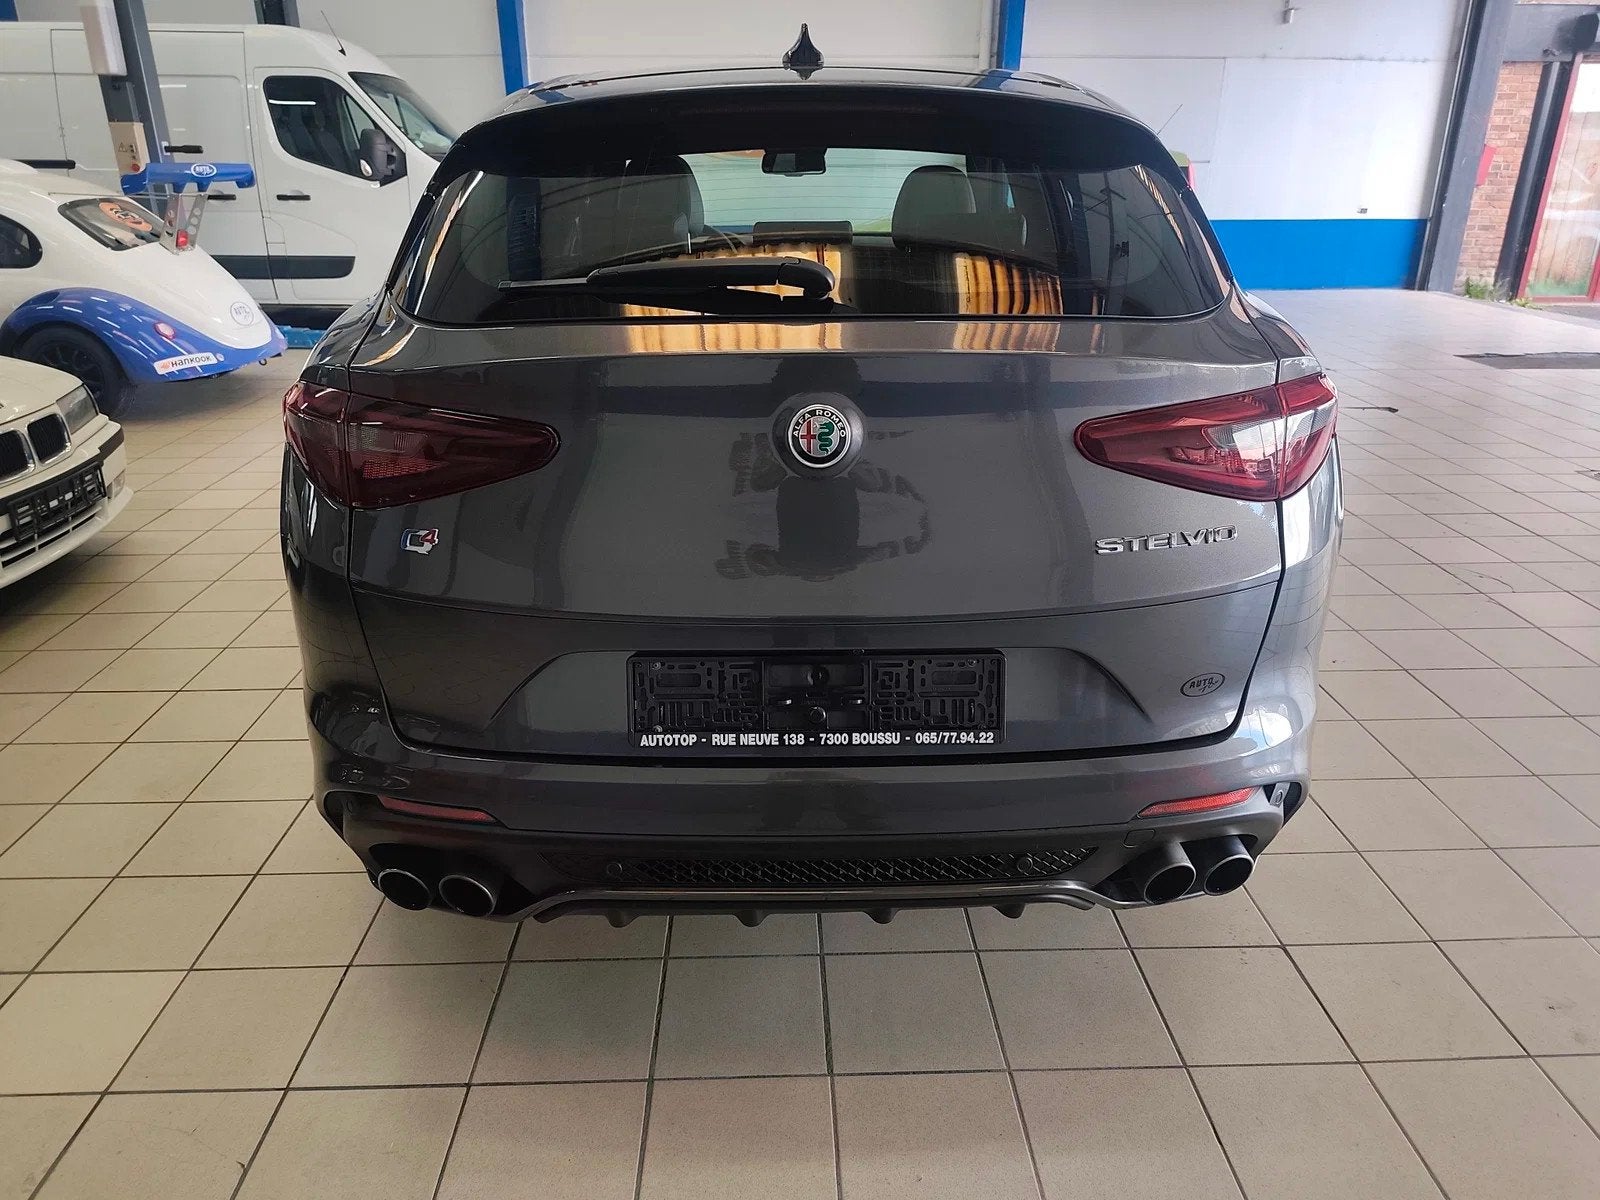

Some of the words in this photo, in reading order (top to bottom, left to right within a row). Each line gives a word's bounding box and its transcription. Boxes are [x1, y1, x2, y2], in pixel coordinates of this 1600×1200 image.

[793, 413, 811, 437] ALFA
[816, 410, 846, 437] ROMEO
[1095, 525, 1239, 555] STELVIO
[1189, 678, 1214, 689] AUTO
[640, 734, 698, 747] AUTOTOP
[711, 733, 737, 746] RUE
[739, 733, 780, 746] NEUVE
[782, 733, 805, 745] 138
[819, 733, 849, 745] 7300
[852, 732, 901, 745] BOUSSU
[915, 731, 995, 744] 065/77.94.22
